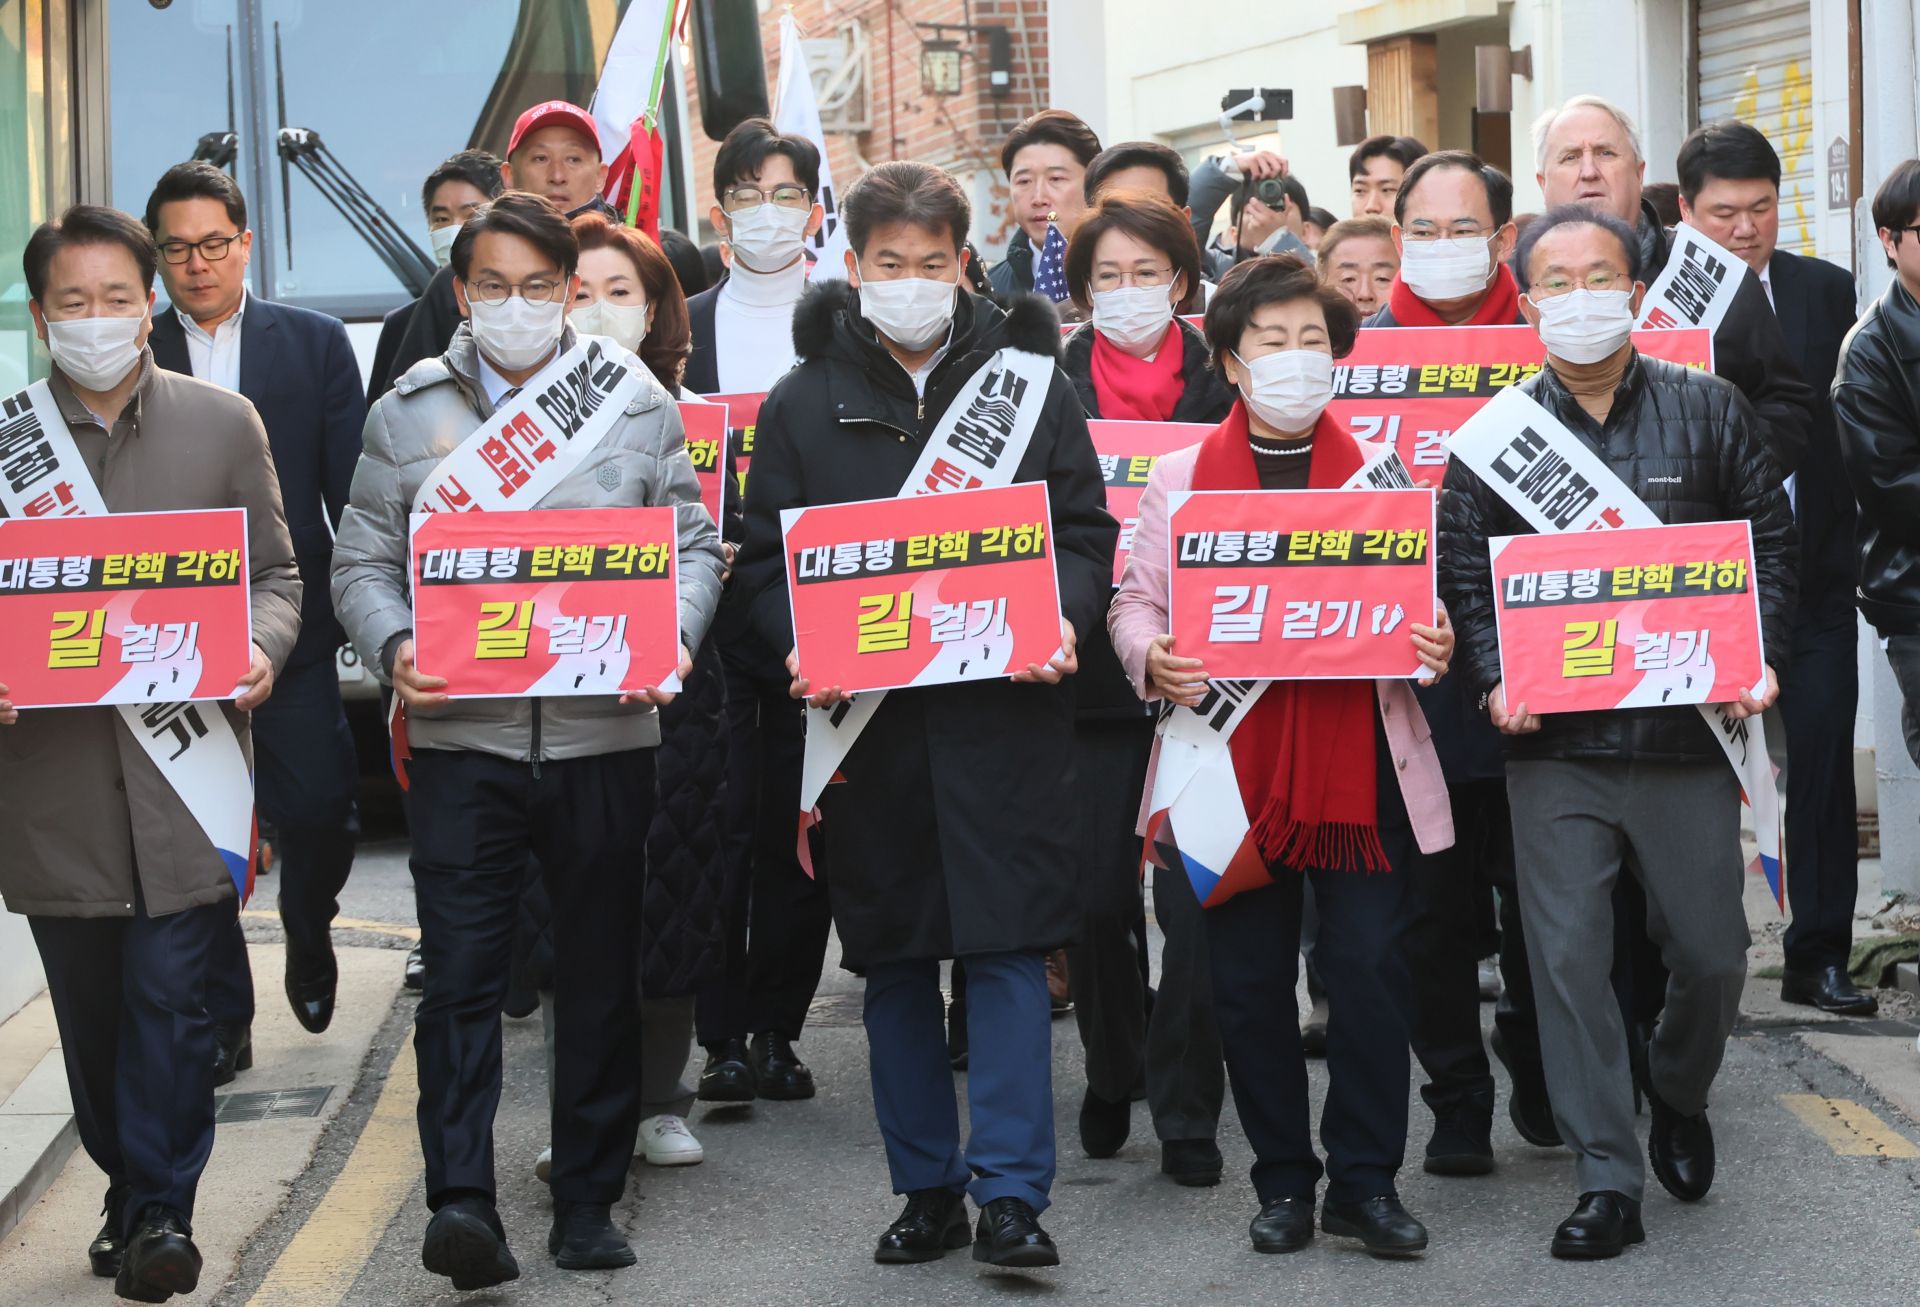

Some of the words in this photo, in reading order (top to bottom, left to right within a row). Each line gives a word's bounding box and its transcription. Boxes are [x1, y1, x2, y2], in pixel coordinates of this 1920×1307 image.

[531, 105, 549, 120] STOP
[1831, 171, 1848, 203] 19-1
[1664, 240, 1727, 326] 대통령
[536, 340, 628, 441] 대통령
[1418, 363, 1480, 393] 탄핵
[947, 369, 1029, 469] 대통령
[477, 411, 558, 499] 탄핵
[1490, 426, 1599, 530] 대통령
[0, 555, 92, 589] 대통령
[102, 551, 167, 585] 탄핵
[176, 548, 241, 581] 각하
[423, 546, 521, 580] 대통령
[530, 543, 596, 577] 탄핵
[605, 542, 670, 575] 각하
[800, 538, 895, 578] 대통령
[906, 529, 970, 567] 탄핵
[981, 521, 1045, 557] 각하
[1180, 530, 1279, 562] 대통령
[1287, 529, 1353, 561] 탄핵
[1363, 528, 1428, 560] 각하
[1506, 567, 1601, 603] 대통령
[1611, 562, 1674, 596] 탄핵
[1684, 559, 1748, 591] 각하
[47, 608, 106, 669] 길
[120, 621, 200, 663] 걷기
[474, 600, 535, 660] 길
[547, 614, 628, 656] 걷기
[857, 591, 914, 654] 길
[930, 597, 1008, 644] 걷기
[1208, 584, 1269, 642] 길
[1281, 600, 1362, 639] 걷기
[1561, 618, 1617, 678] 길
[1633, 629, 1710, 671] 걷기
